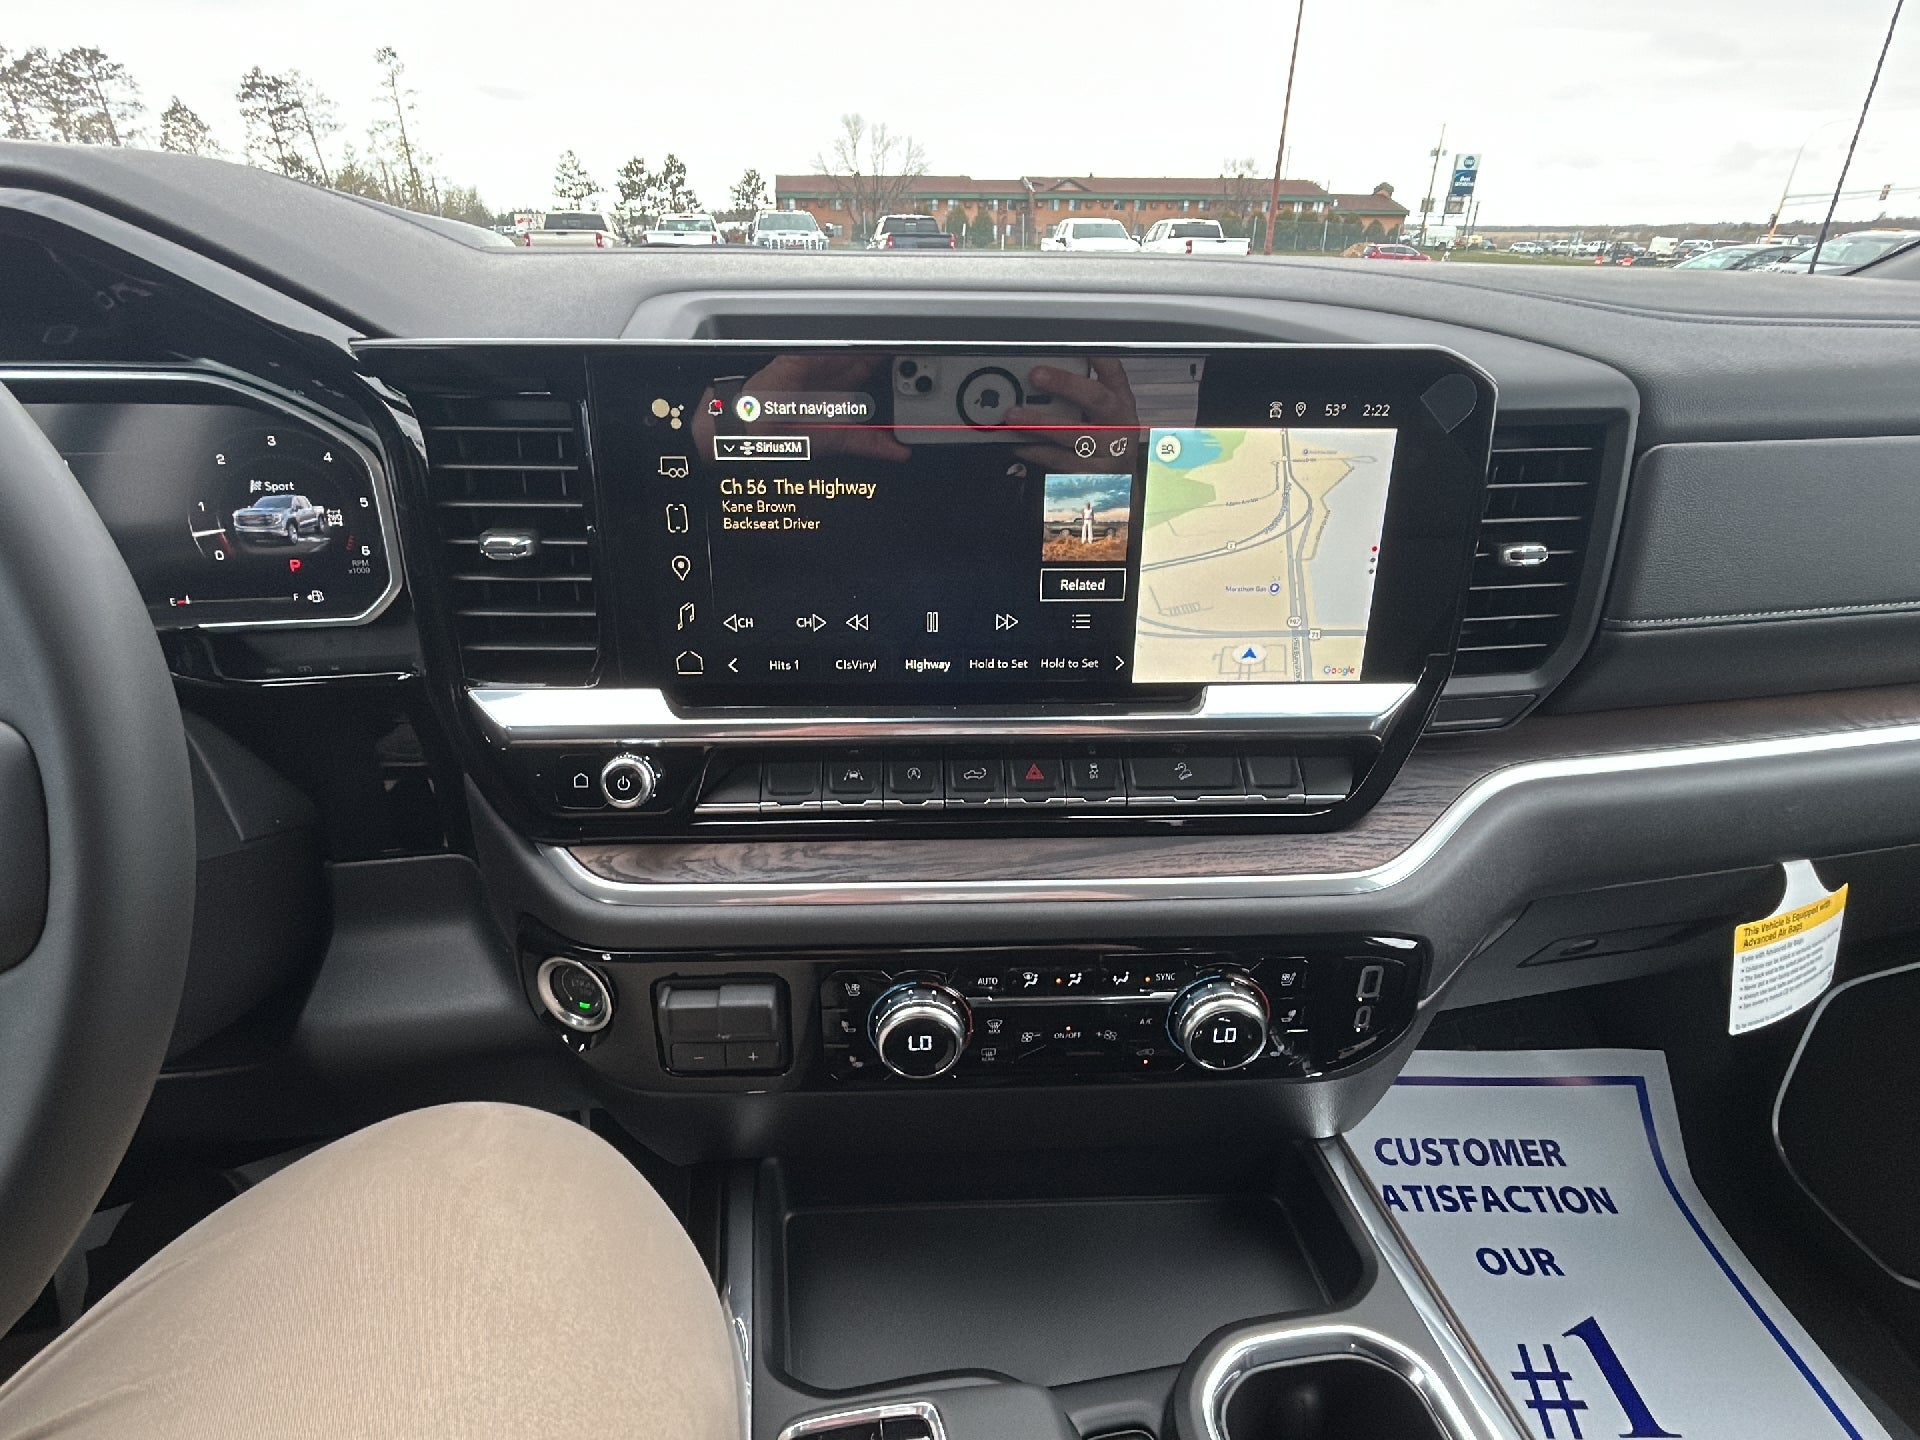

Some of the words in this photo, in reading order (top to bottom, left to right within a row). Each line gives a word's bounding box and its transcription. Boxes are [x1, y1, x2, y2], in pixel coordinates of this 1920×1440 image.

[764, 402, 797, 415] Start
[799, 402, 867, 417] navigation
[1324, 404, 1347, 417] 53°
[1362, 404, 1391, 417] 2:22
[267, 435, 276, 446] 3
[756, 440, 802, 453] SiriusXM
[216, 453, 226, 465] 2
[323, 451, 332, 462] 4
[265, 482, 295, 493] Sport
[720, 478, 743, 495] Ch
[747, 479, 767, 495] 56
[774, 479, 804, 495] The
[809, 478, 877, 499] Highway
[199, 501, 205, 512] 1
[359, 497, 369, 507] 5
[722, 501, 753, 513] Kane
[757, 501, 796, 513] Brown
[724, 518, 779, 530] Backseat
[783, 518, 821, 530] Driver
[215, 550, 225, 561] 0
[361, 545, 371, 556] 6
[289, 559, 301, 572] P
[1061, 579, 1106, 591] Related
[169, 597, 176, 606] E
[293, 593, 299, 601] F
[738, 617, 754, 629] CH
[796, 617, 812, 629] CH
[769, 659, 791, 671] Hits
[794, 659, 799, 670] 1
[835, 659, 877, 673] ClsVinyl
[905, 659, 951, 673] Highway
[969, 659, 994, 670] Hold
[997, 660, 1008, 670] to
[1011, 659, 1028, 670] Set
[1041, 658, 1065, 669] Hold
[1067, 659, 1079, 669] to
[1081, 658, 1099, 669] Set
[1323, 665, 1356, 677] Google
[1744, 926, 1760, 937] This
[1762, 918, 1785, 932] Vehicle
[1792, 905, 1819, 922] Equipped
[1743, 932, 1777, 948] Advanced
[1778, 928, 1787, 938] Air
[978, 977, 998, 985] AUTO
[1213, 1027, 1237, 1042] LO
[908, 1035, 932, 1050] LO
[1374, 1137, 1566, 1167] CUSTOMER
[1382, 1184, 1619, 1214] ATISFACTION
[1476, 1247, 1565, 1276] OUR
[1511, 1316, 1682, 1440] #1
